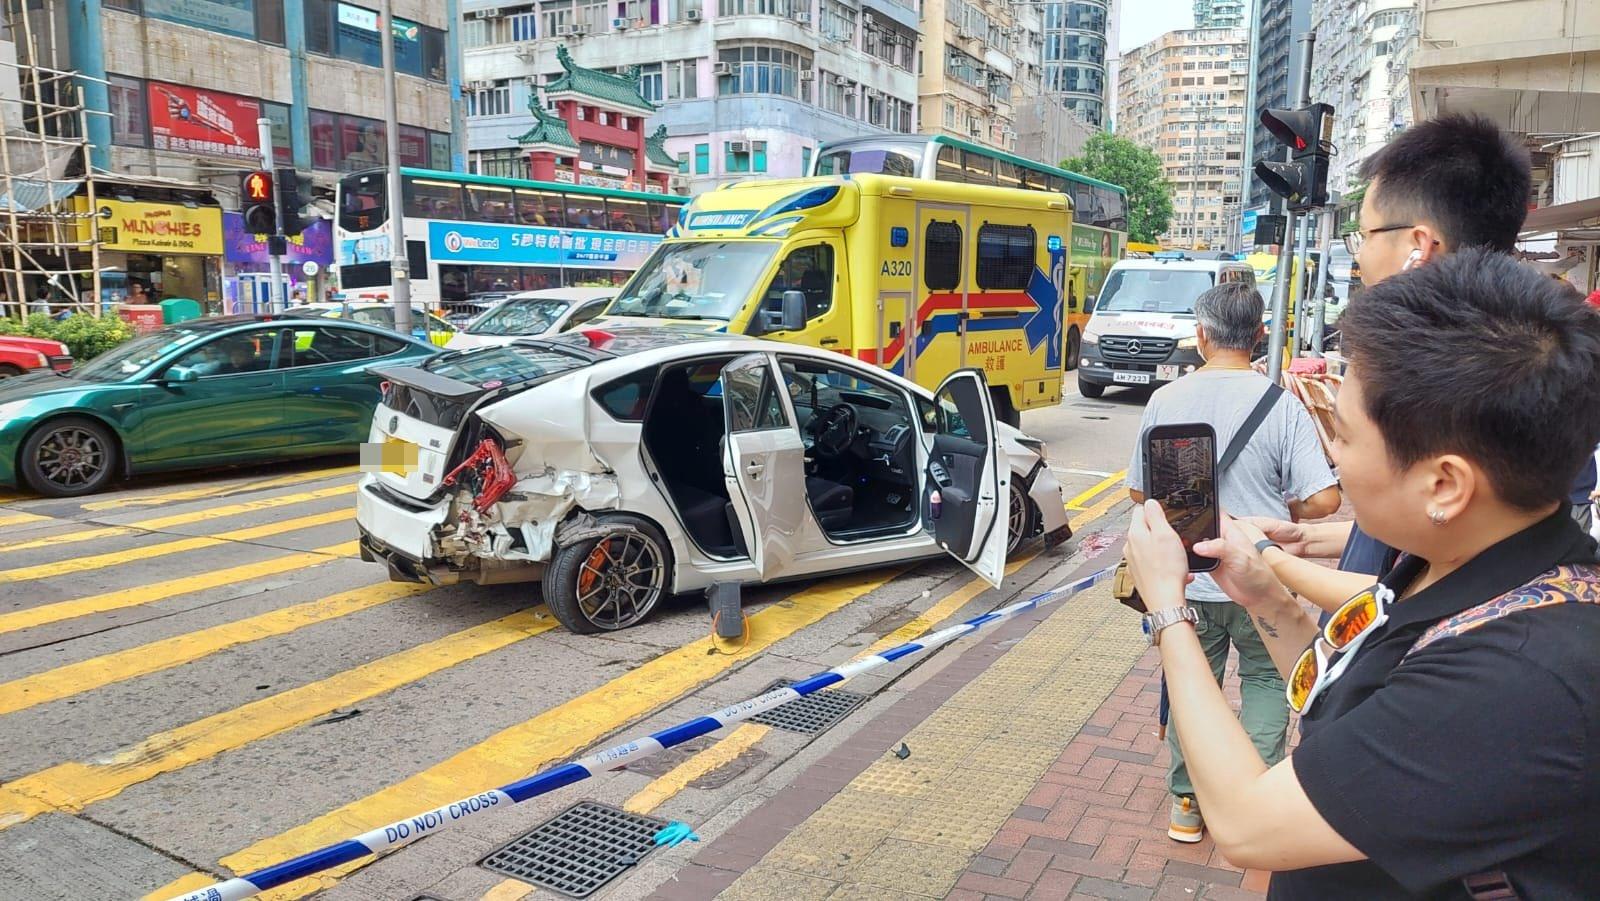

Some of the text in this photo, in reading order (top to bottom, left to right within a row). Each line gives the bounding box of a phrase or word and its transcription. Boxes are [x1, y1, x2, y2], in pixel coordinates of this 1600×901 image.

[122, 219, 201, 237] MUNCHIES
[462, 237, 499, 249] WeLend
[881, 261, 911, 276] A320
[968, 339, 1023, 355] AMBULANCE
[985, 355, 1006, 372] 救護
[385, 791, 499, 843] DO NOT CROSS
